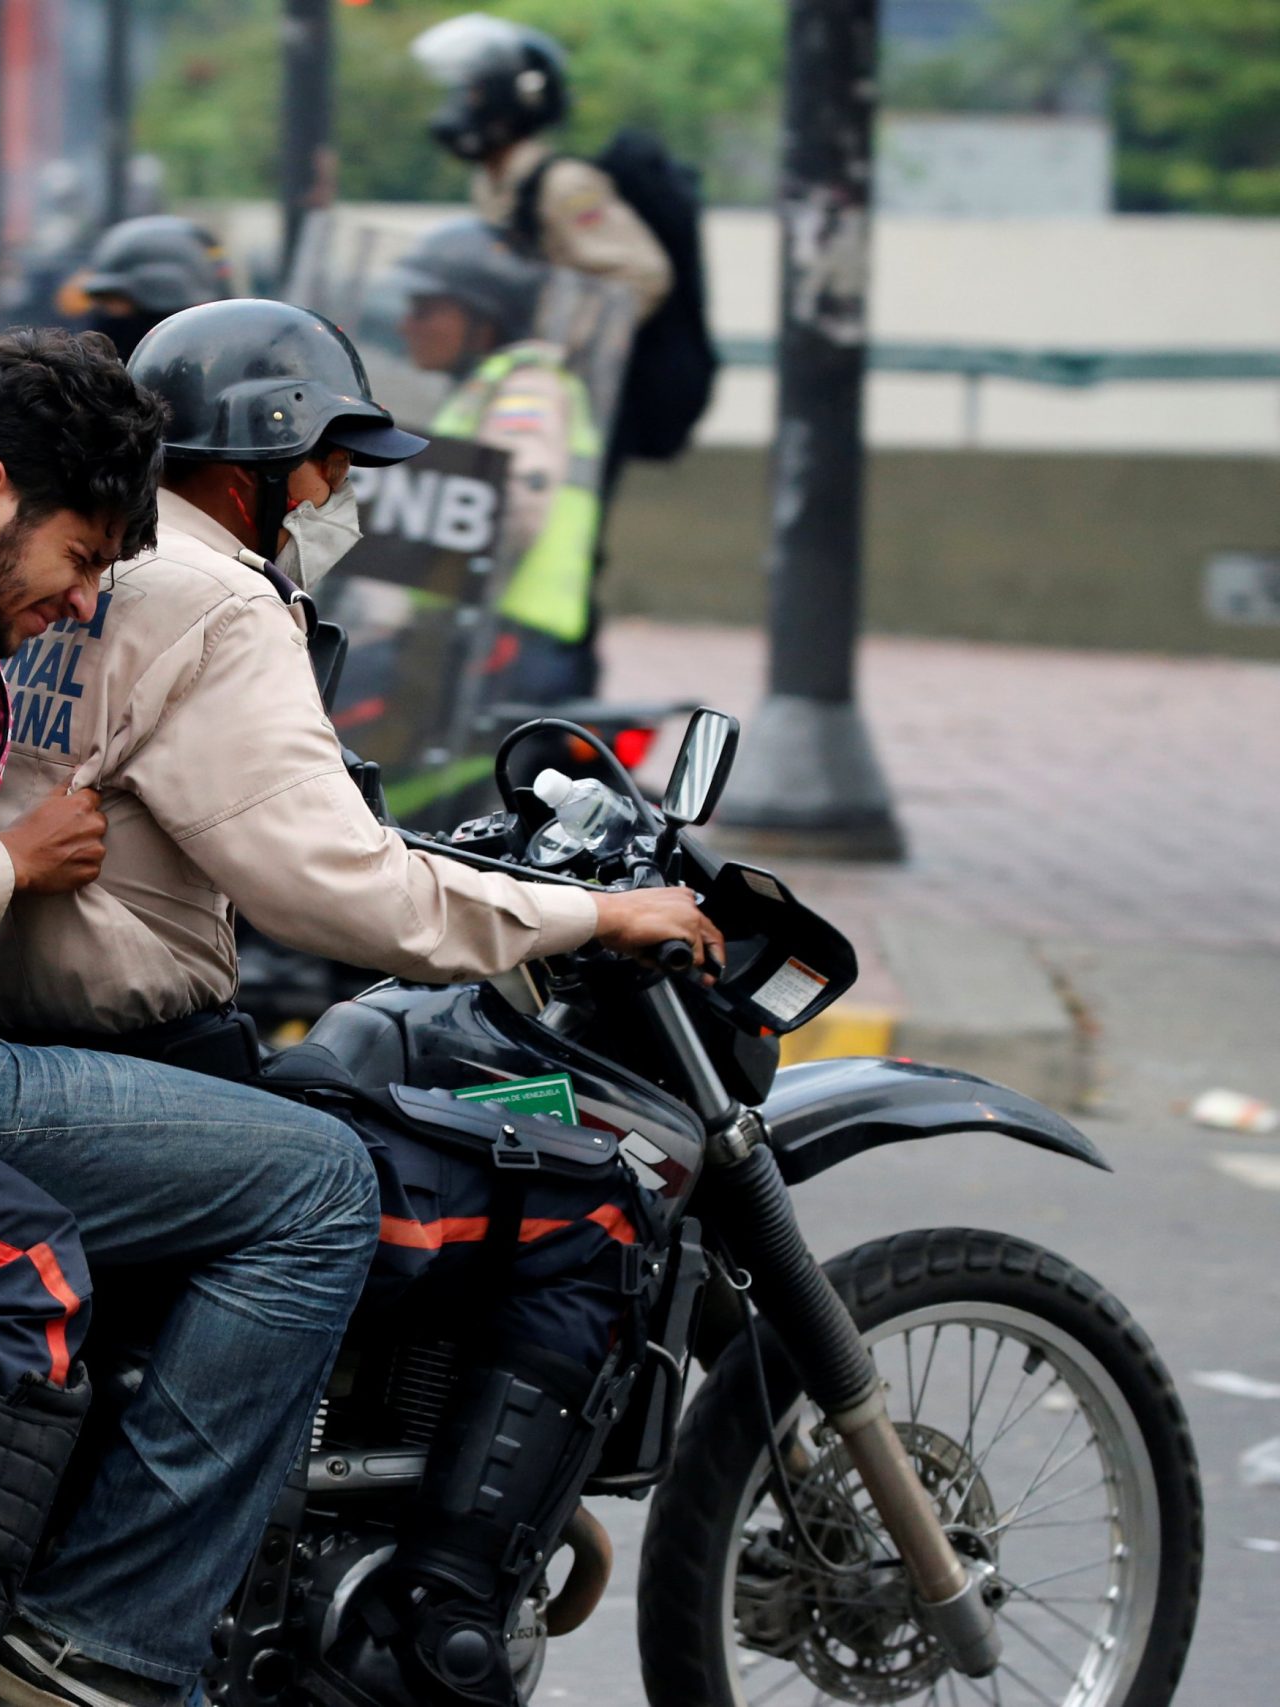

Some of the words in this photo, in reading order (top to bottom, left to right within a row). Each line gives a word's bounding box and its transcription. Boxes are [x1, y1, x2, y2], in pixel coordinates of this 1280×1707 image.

[1, 637, 84, 699] NAL
[8, 690, 73, 754] ANA
[521, 1089, 561, 1100] VENEZUELA
